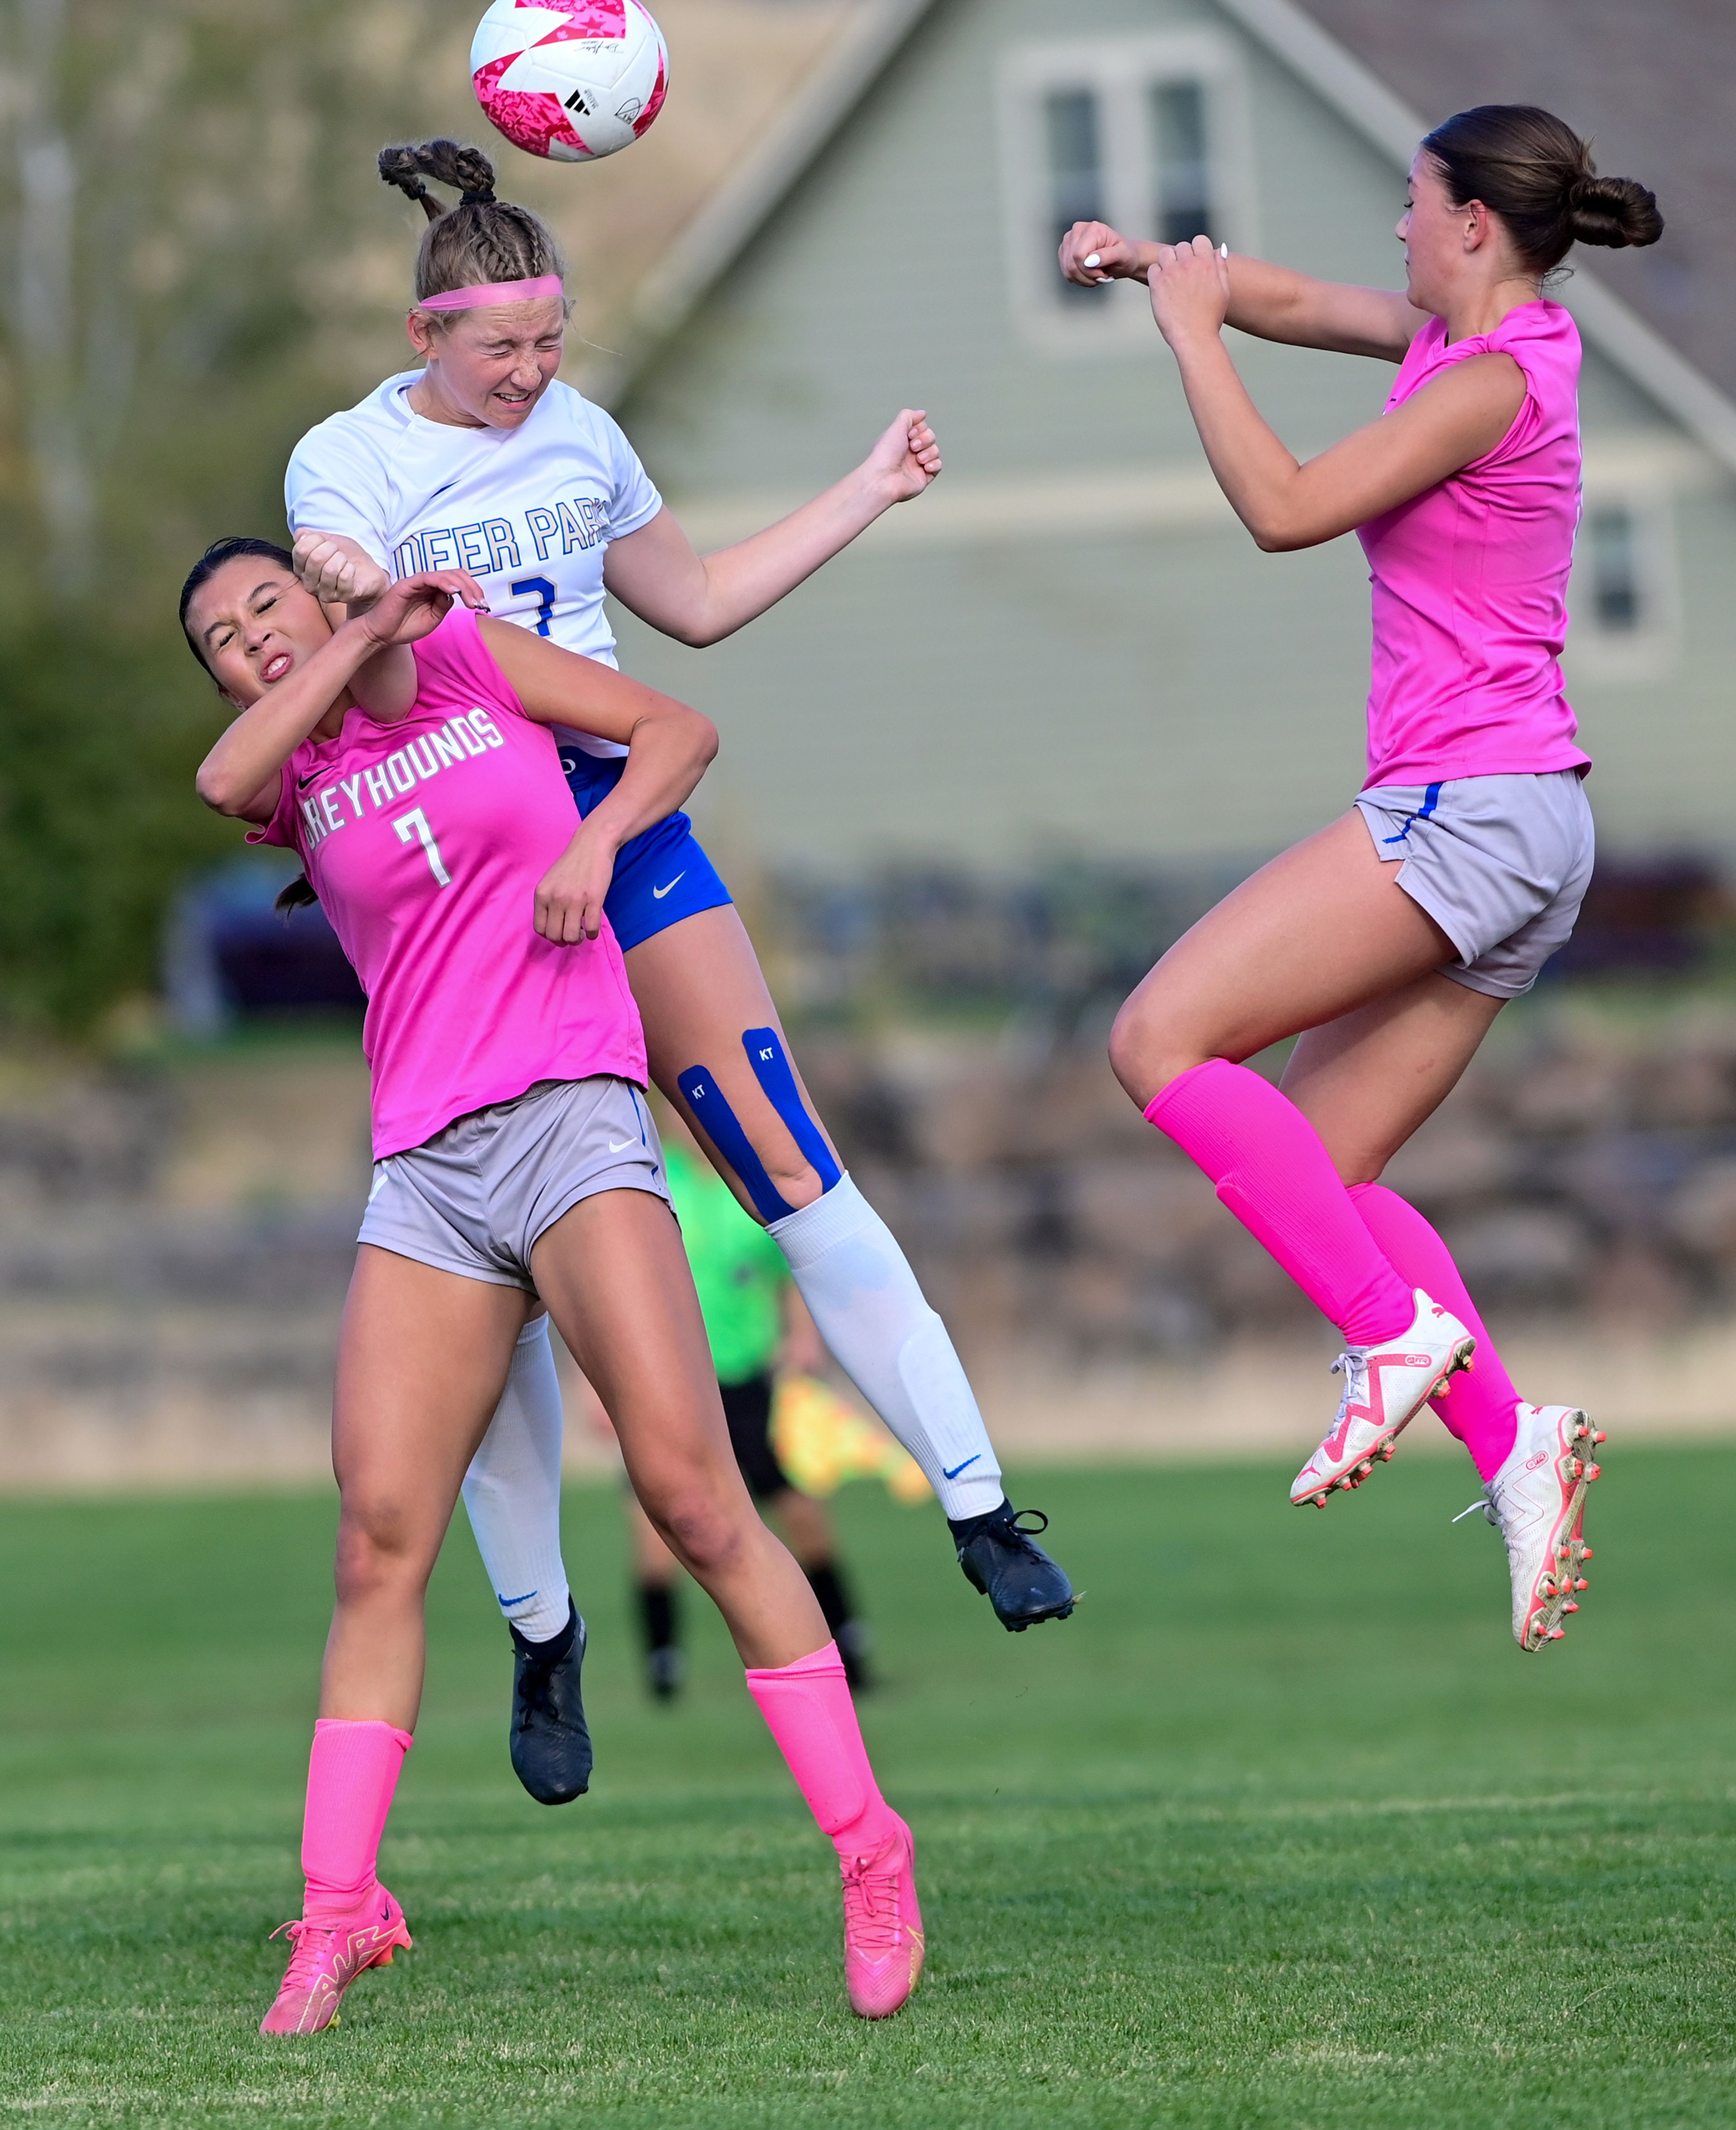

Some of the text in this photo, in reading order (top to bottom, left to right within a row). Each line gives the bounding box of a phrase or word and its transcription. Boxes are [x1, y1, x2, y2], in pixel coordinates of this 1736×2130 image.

[393, 517, 522, 580] DEER
[391, 805, 452, 888] 7
[759, 1047, 774, 1061] KT
[692, 1084, 705, 1100] KT
